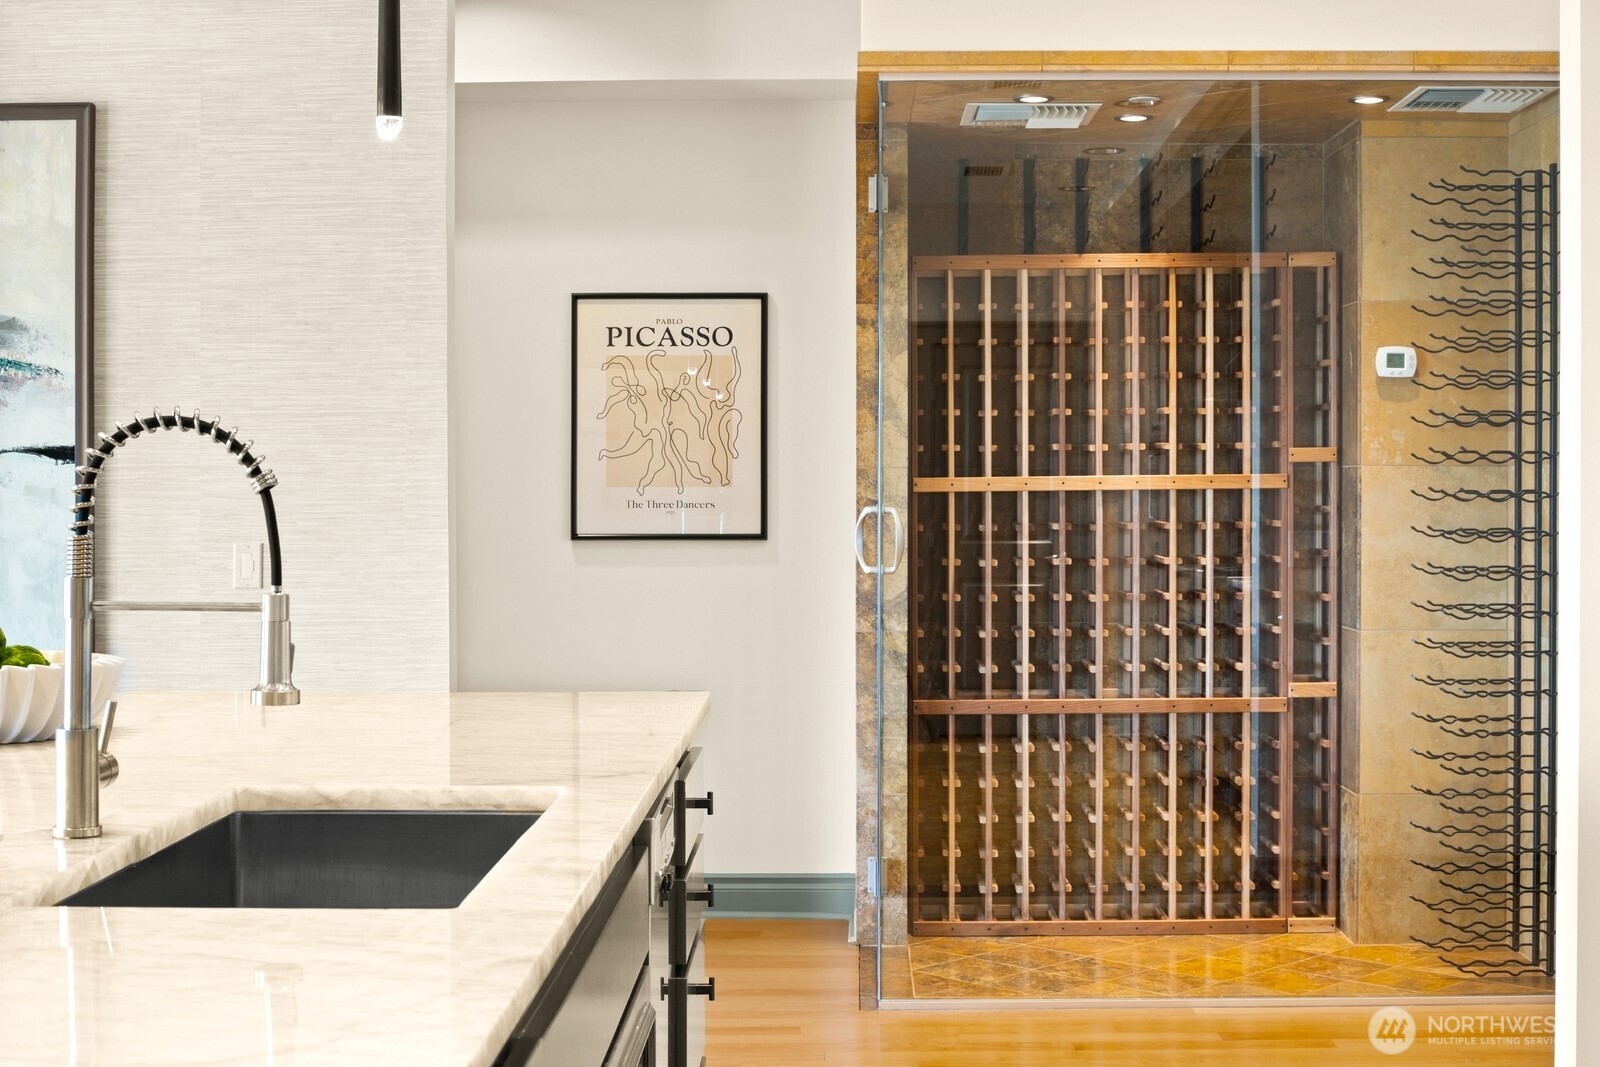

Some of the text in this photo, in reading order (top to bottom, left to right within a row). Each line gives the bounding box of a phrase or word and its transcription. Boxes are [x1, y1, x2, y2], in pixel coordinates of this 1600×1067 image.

[606, 326, 733, 347] PICASSO
[626, 499, 716, 509] The Three Dancers
